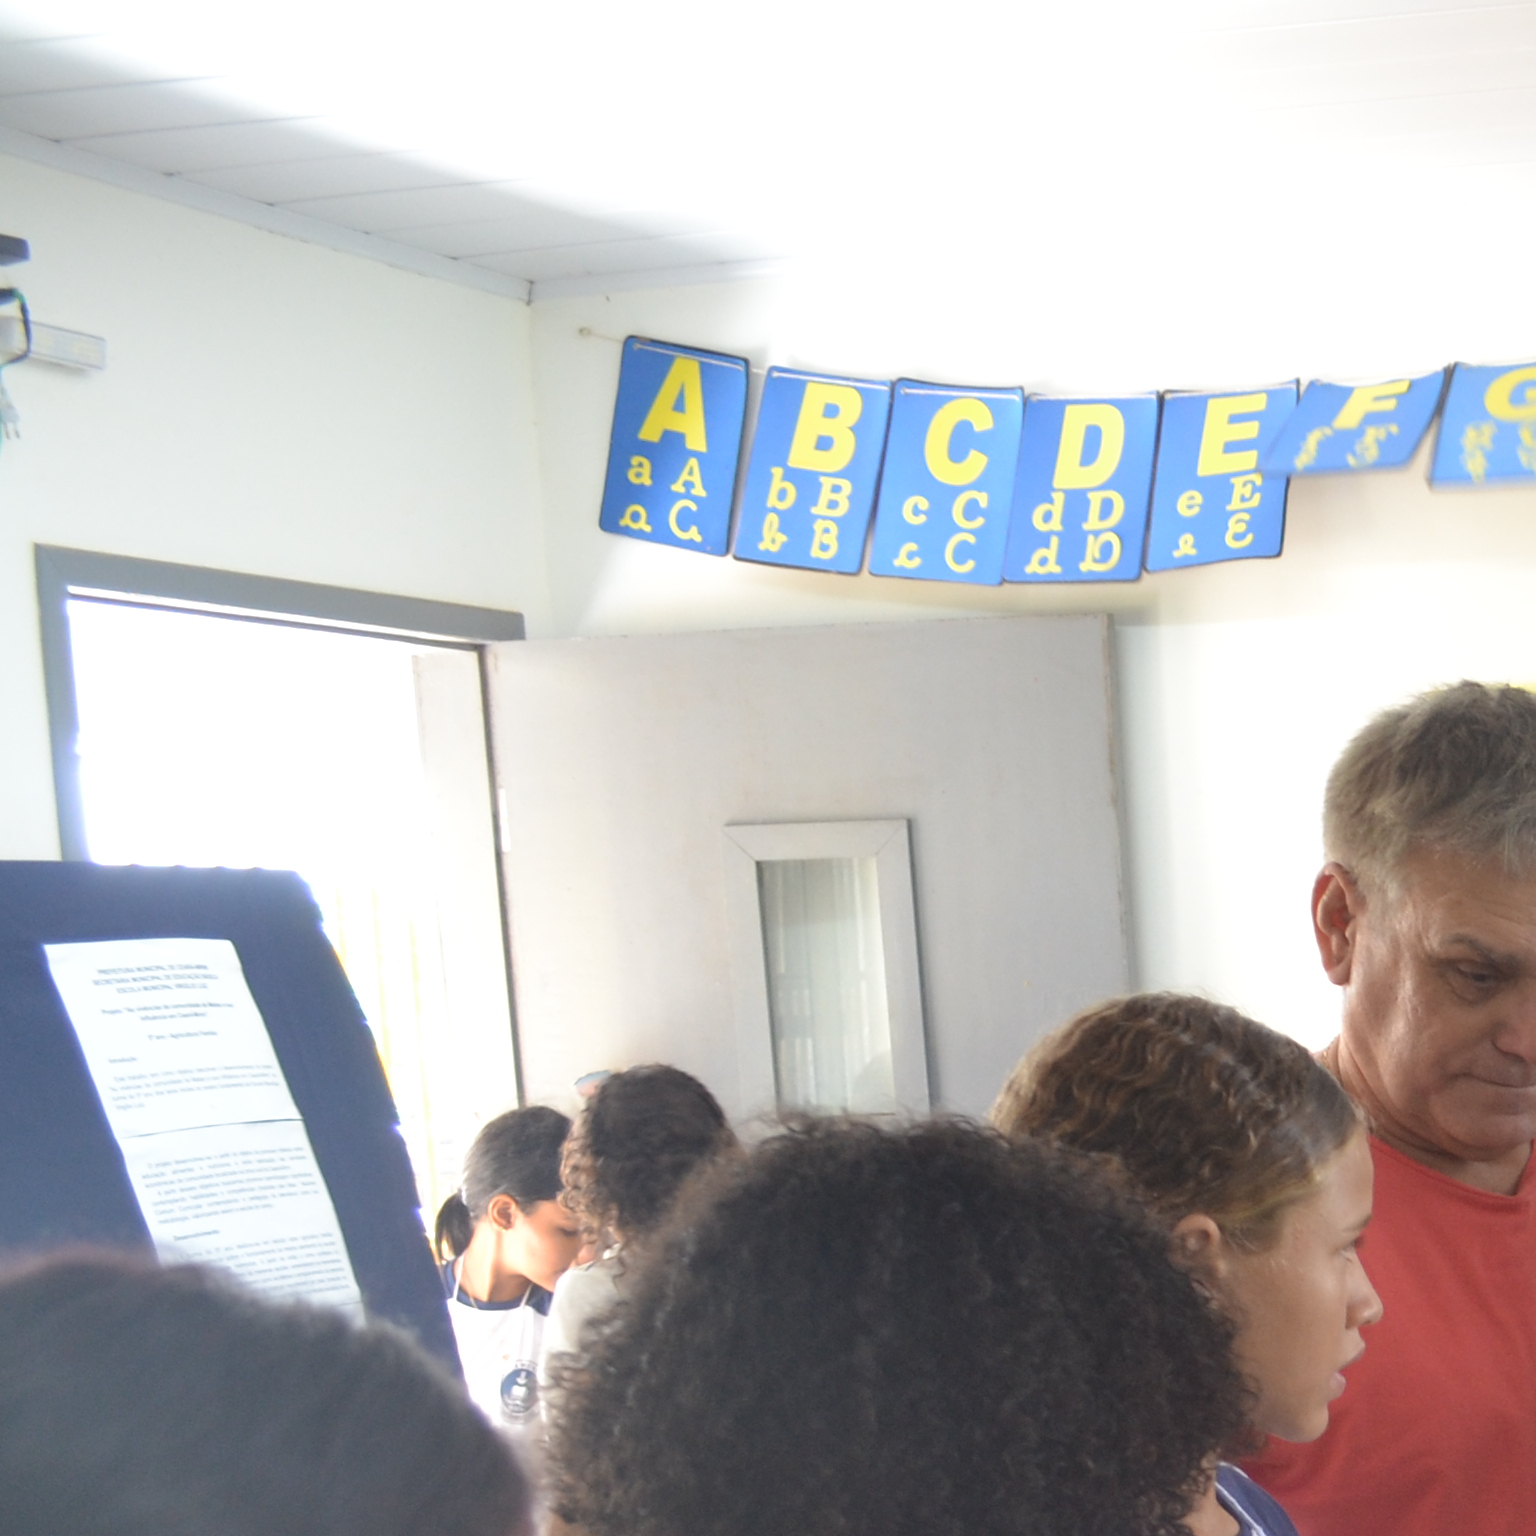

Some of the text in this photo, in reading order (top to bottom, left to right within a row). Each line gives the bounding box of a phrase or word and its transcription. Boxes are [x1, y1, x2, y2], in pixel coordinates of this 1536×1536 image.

[638, 355, 707, 453] A
[1333, 378, 1411, 429] F
[787, 380, 863, 473] B
[925, 397, 994, 486] C
[1052, 403, 1126, 490] D
[1197, 392, 1268, 477] E
[628, 455, 707, 497] a A
[767, 467, 852, 517] b B
[1177, 472, 1263, 517] e E
[620, 504, 652, 532] a
[903, 490, 988, 529] c C
[1033, 490, 1125, 532] d D
[759, 512, 787, 552] b
[1174, 534, 1197, 557] e
[895, 543, 921, 569] c
[1026, 536, 1062, 574] d
